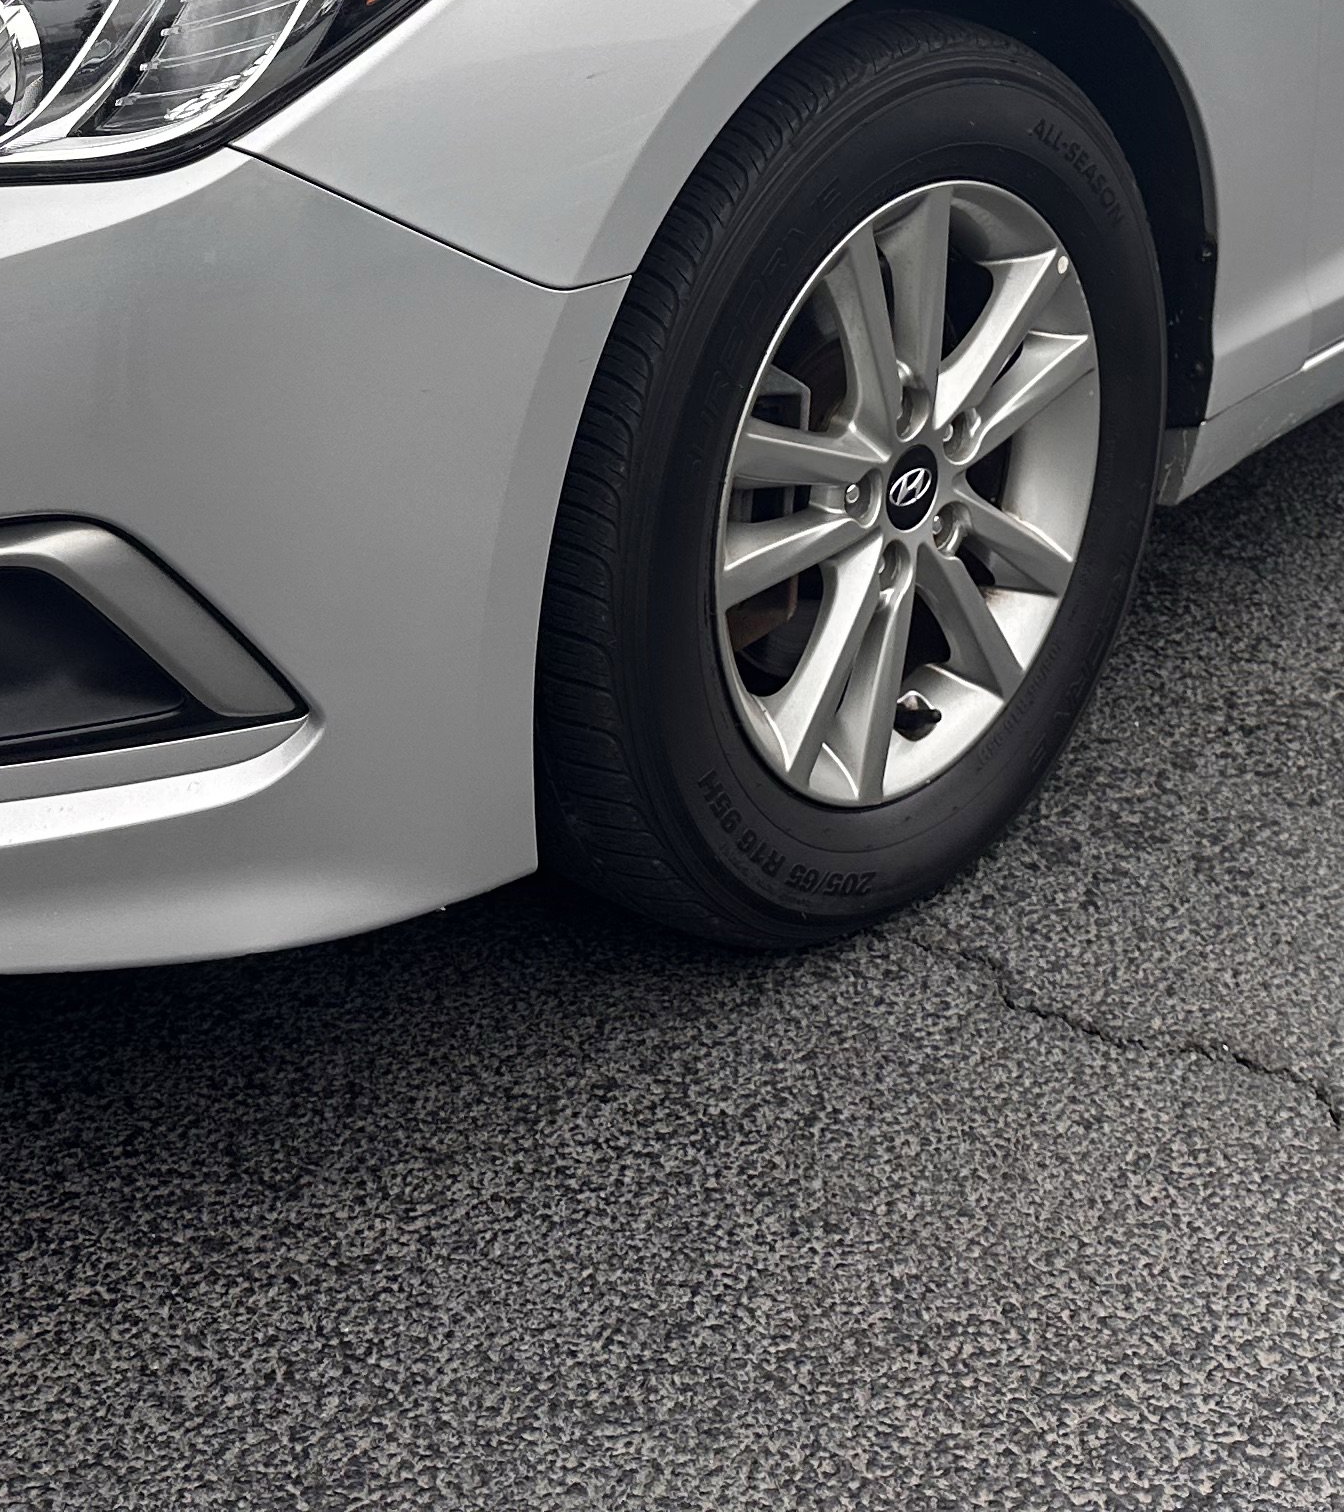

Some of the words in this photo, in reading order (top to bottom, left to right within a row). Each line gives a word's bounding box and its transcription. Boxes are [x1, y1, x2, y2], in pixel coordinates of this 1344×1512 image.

[1033, 118, 1124, 224] ALL-SEASON
[698, 767, 742, 834] 95H
[736, 828, 787, 878] R16
[784, 864, 877, 897] 205/65
